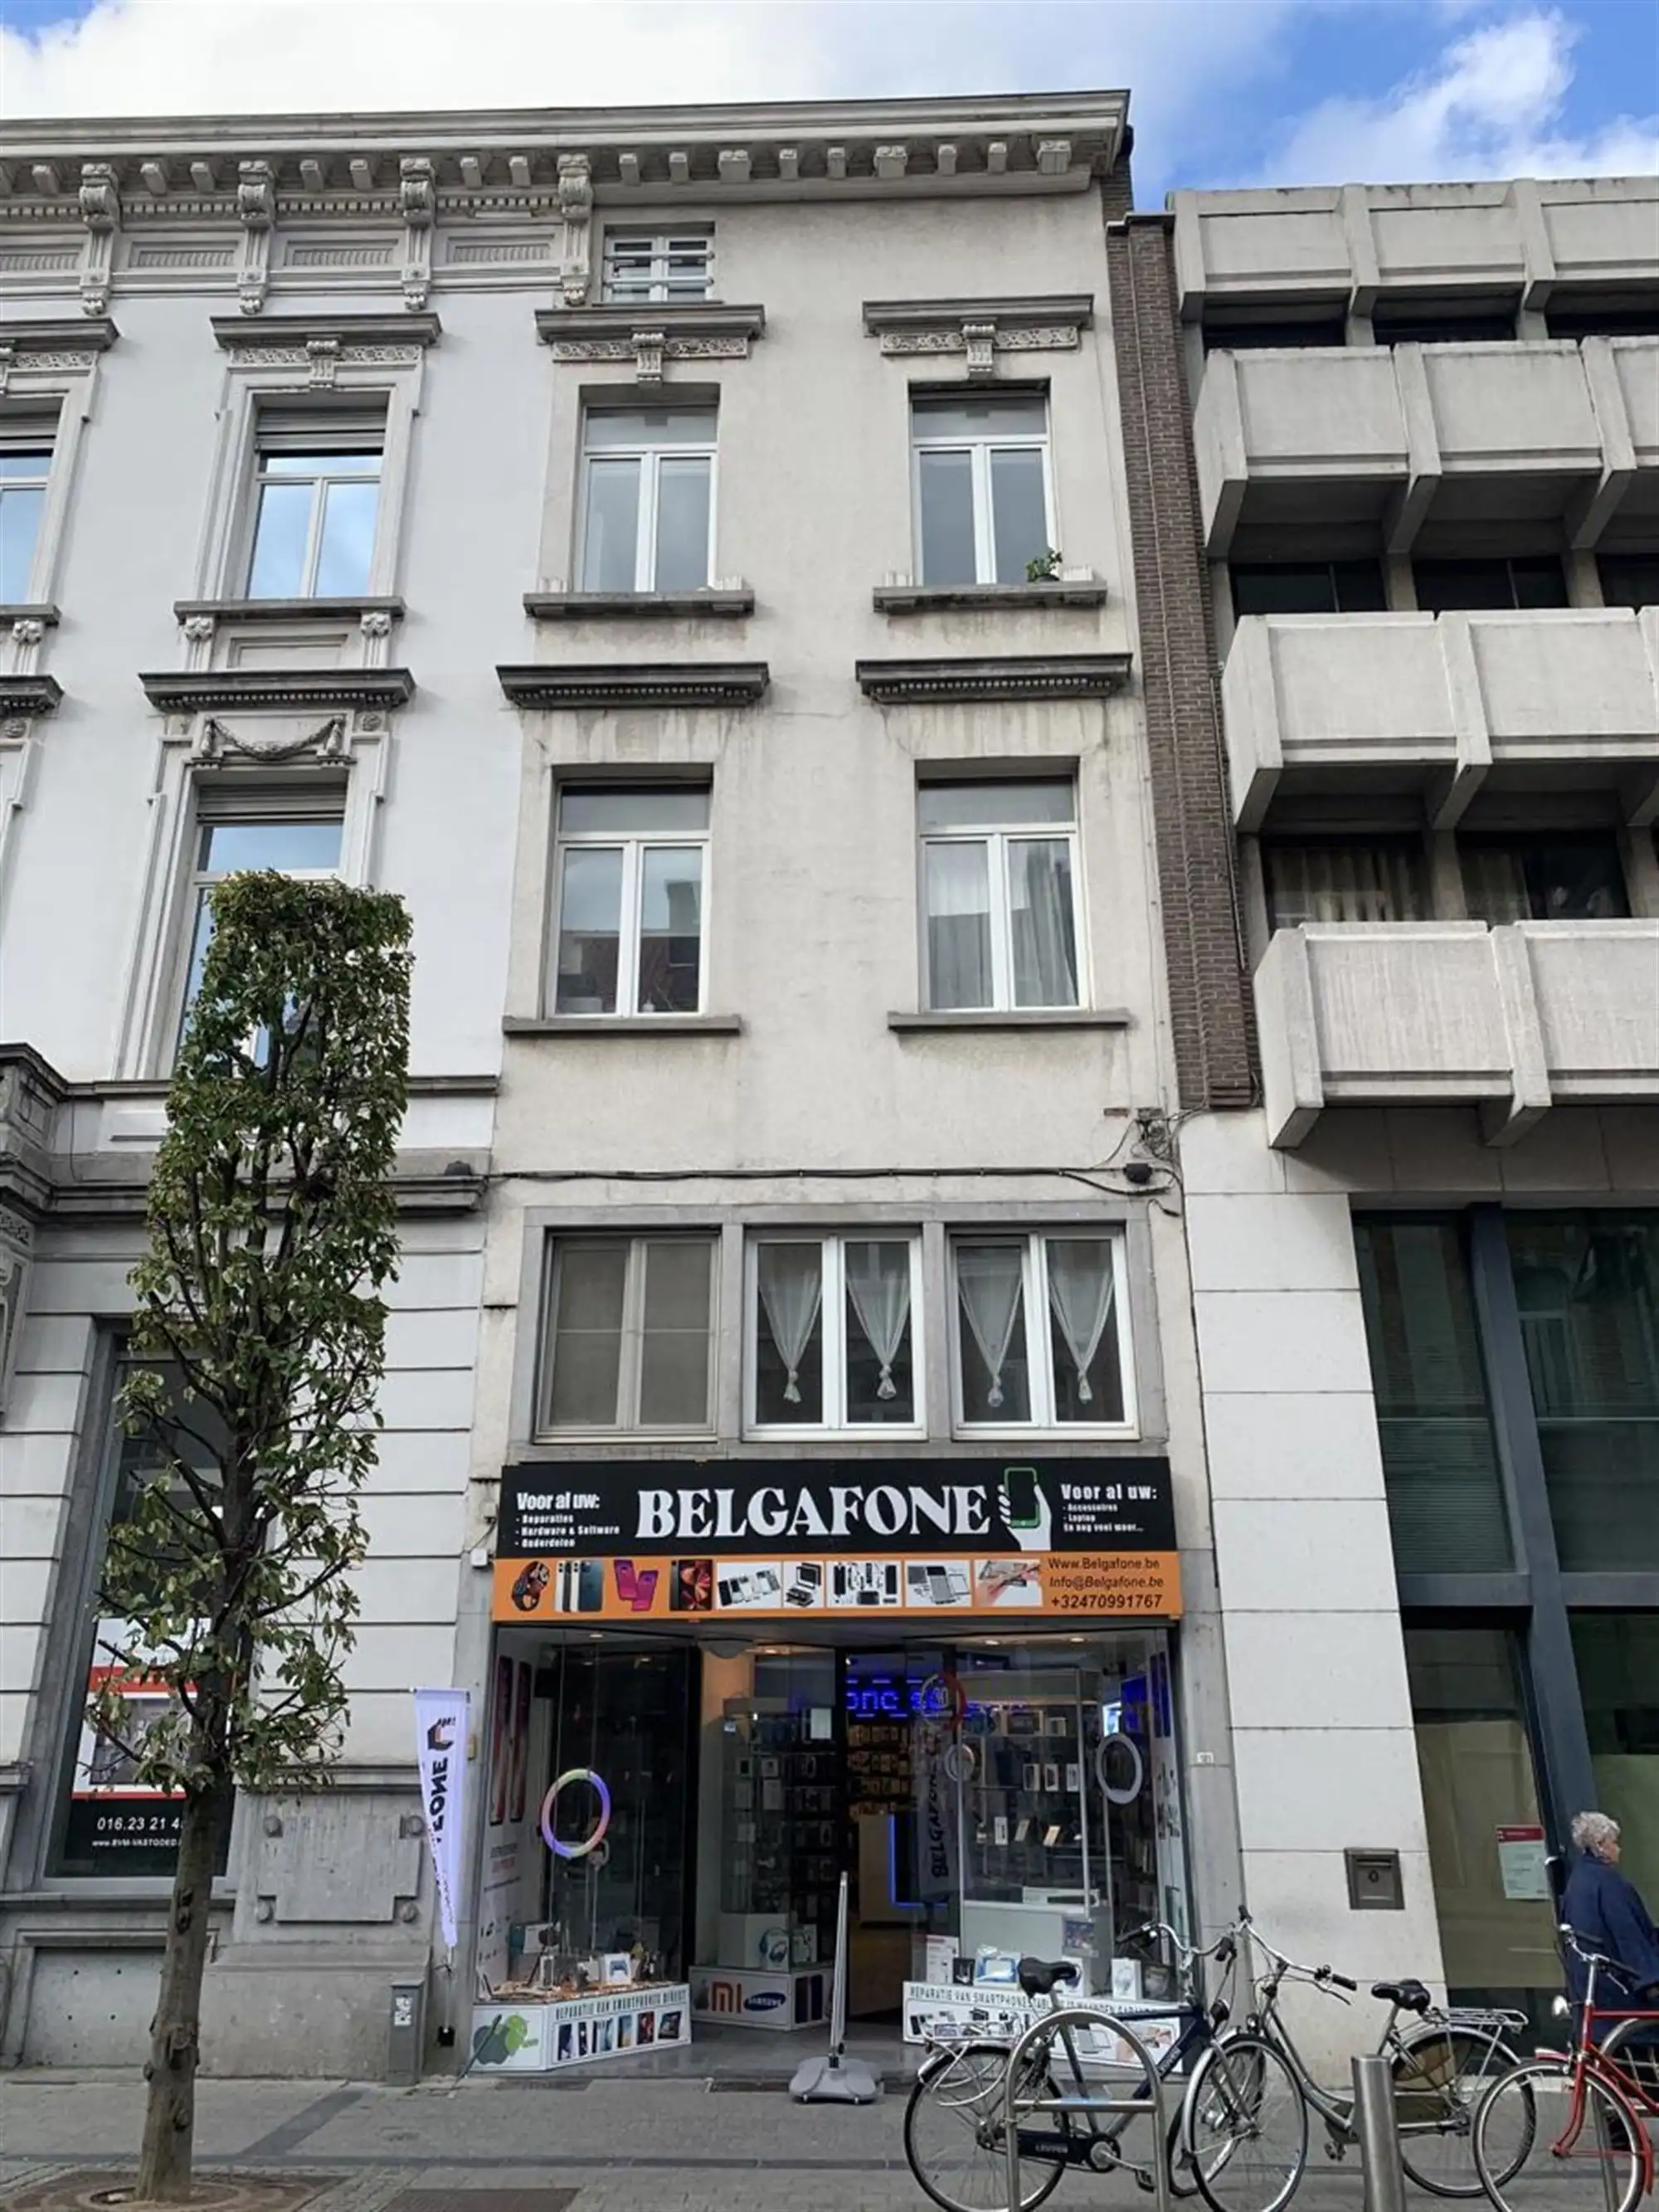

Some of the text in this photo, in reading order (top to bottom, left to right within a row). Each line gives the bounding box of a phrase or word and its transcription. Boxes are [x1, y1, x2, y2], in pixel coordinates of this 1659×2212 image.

[1061, 1484, 1157, 1500] Voor al uw:
[517, 1491, 601, 1510] Voor al uw:
[635, 1485, 990, 1538] BELGAFONE
[522, 1527, 566, 1537] Hardware
[578, 1525, 620, 1536] Software
[1048, 1557, 1160, 1571] Www.Belgafone.be
[1049, 1576, 1165, 1591] Info@Belgafone.be
[1051, 1594, 1163, 1609] +32470991767
[97, 1816, 184, 1830] 016.23 21 4
